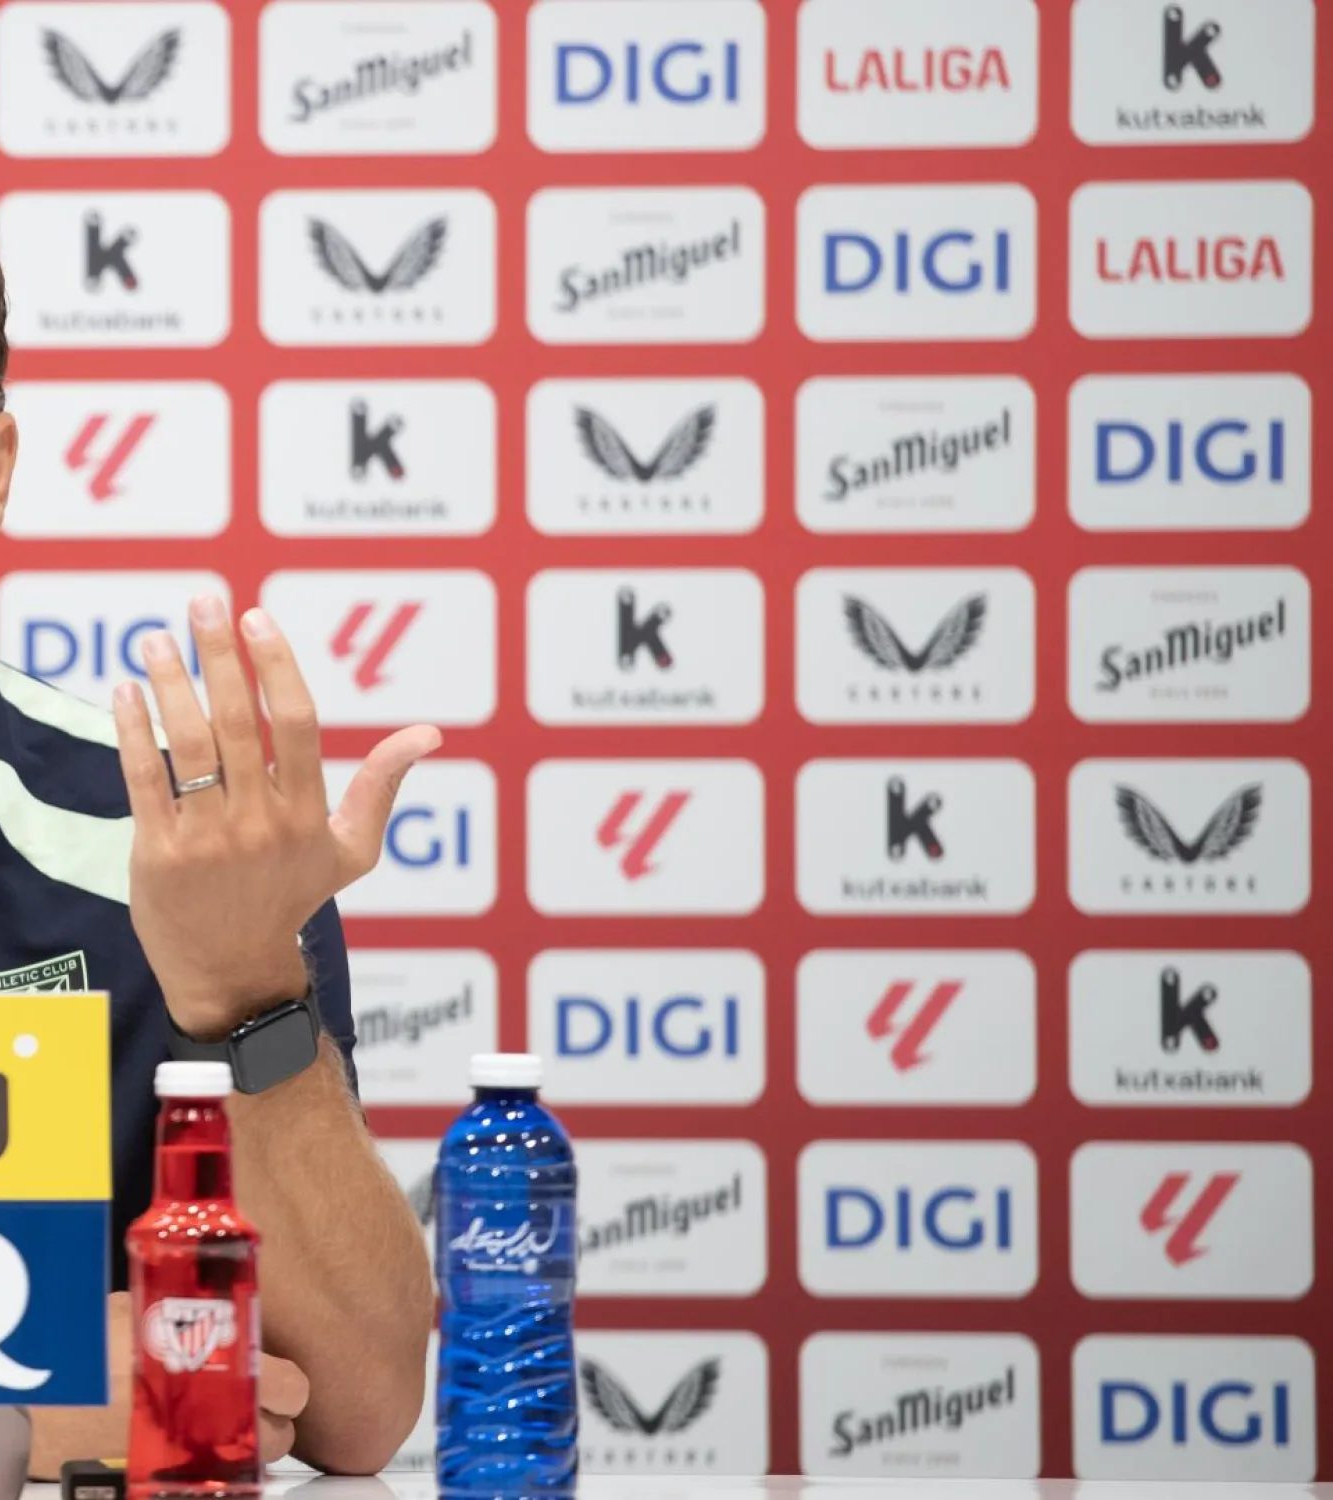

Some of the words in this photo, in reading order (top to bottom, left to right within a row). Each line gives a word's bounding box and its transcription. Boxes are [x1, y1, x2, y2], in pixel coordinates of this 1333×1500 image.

[556, 41, 739, 105] DIGI
[825, 46, 1010, 92] LALIGA
[1117, 104, 1266, 129] kutxabank
[824, 230, 1009, 294] DIGI
[1097, 236, 1285, 282] LALIGA
[1096, 419, 1284, 484] DIGI
[1098, 598, 1286, 692] SanMiguel
[572, 688, 716, 710] kutxabank
[384, 806, 470, 868] GI
[842, 877, 987, 900] kutxabank
[42, 959, 77, 979] CLUB
[356, 980, 472, 1048] Miguel
[556, 996, 738, 1059] DIGI
[1116, 1069, 1263, 1092] kutxabank
[578, 1174, 741, 1257] anMiguel
[826, 1187, 1012, 1251] DIGI
[1100, 1381, 1289, 1447] DIGI
